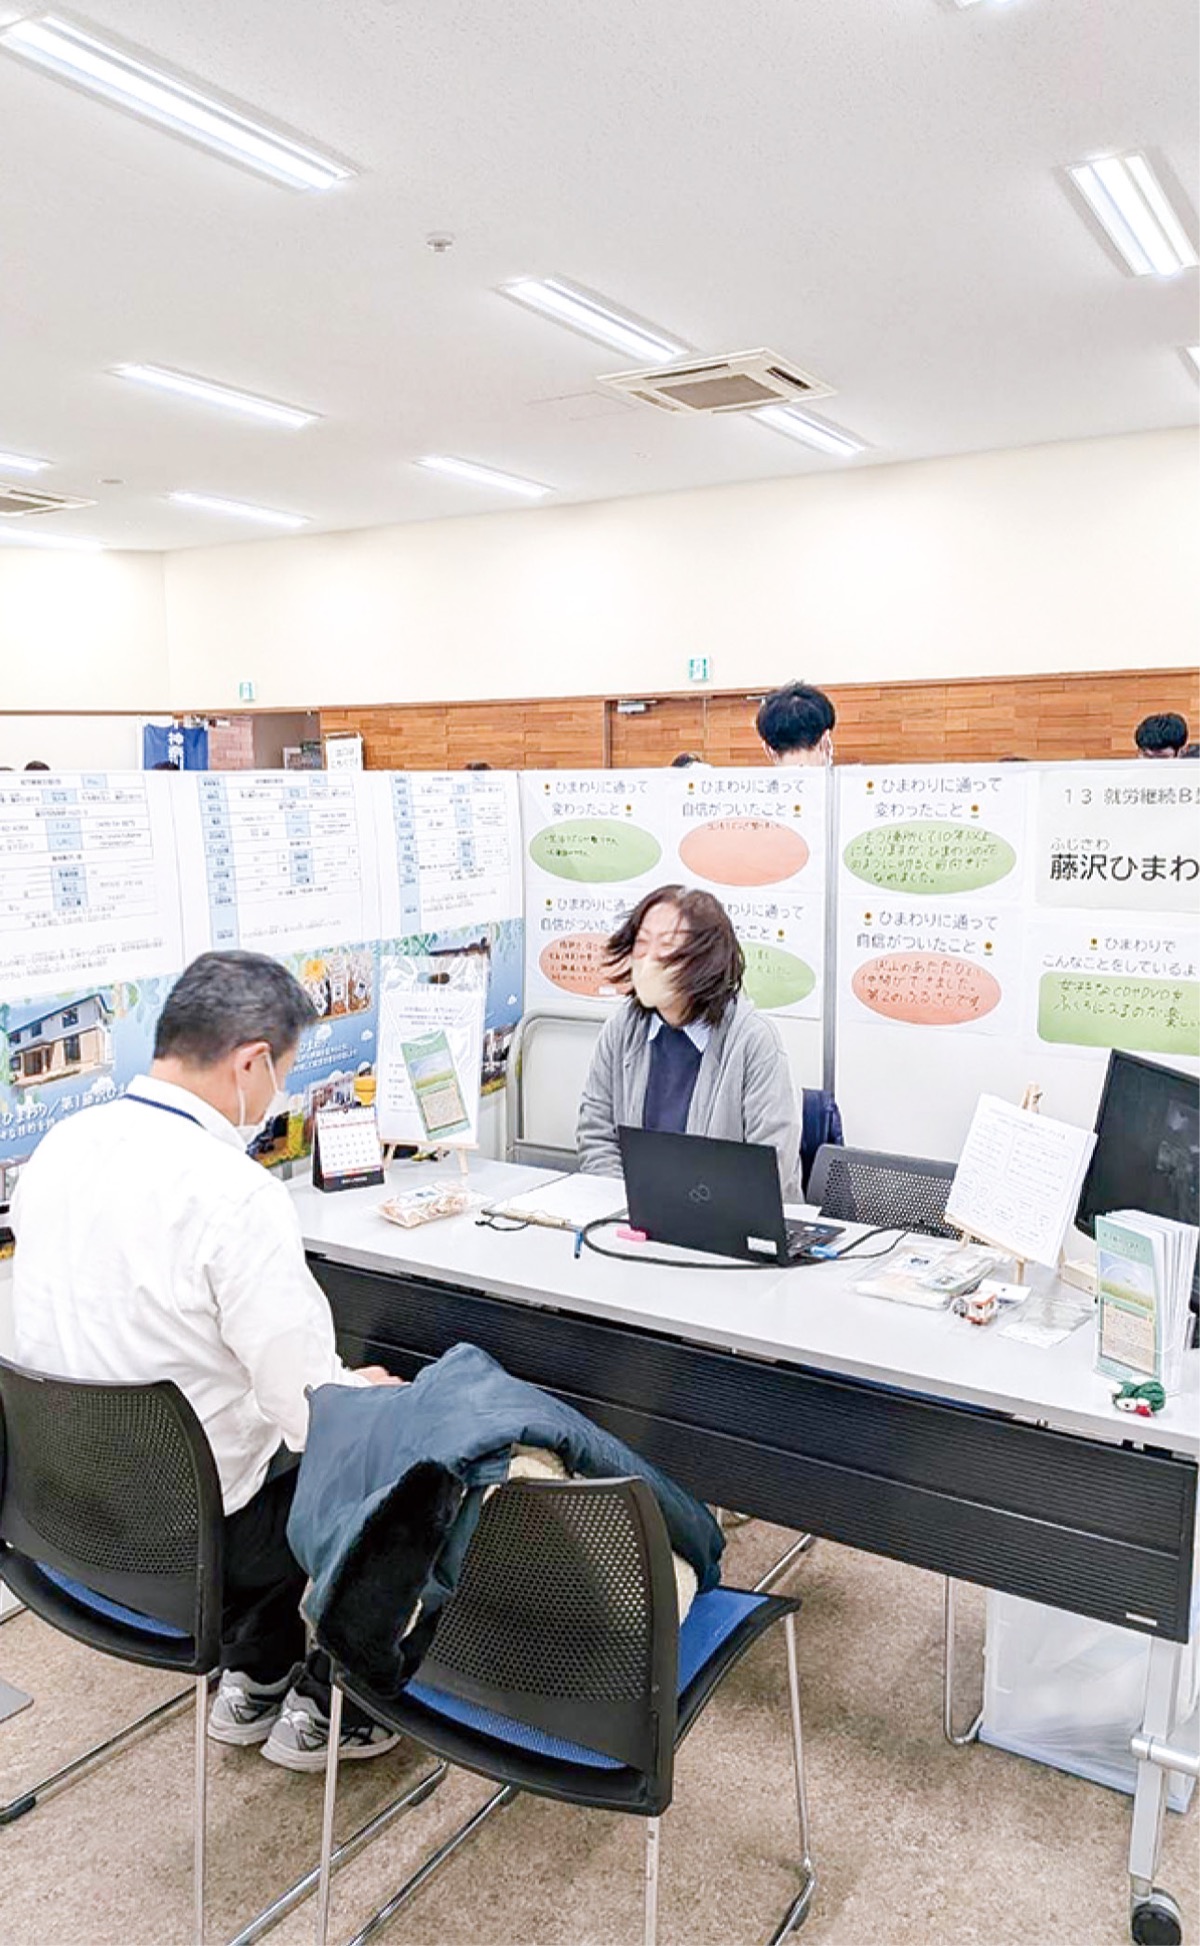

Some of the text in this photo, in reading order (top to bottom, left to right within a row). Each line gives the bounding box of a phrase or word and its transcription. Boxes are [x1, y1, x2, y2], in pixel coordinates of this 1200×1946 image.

[556, 780, 648, 795] ひまわりに通って
[701, 779, 805, 795] ひまわりに通って
[880, 776, 1002, 793] ひまわりに通って
[1103, 787, 1200, 806] 就労継続B
[552, 802, 621, 817] 変わったこと
[682, 802, 787, 818] 自信がついたこと
[875, 802, 963, 818] 変わったこと
[1050, 837, 1110, 851] ふじさわ
[1049, 853, 1200, 882] 藤沢ひまわ
[879, 911, 999, 931] ひまわりに通って
[856, 932, 976, 954] 自信がついたこと
[1105, 937, 1177, 953] ひまわりで
[1042, 954, 1197, 976] こんなことをしているよ
